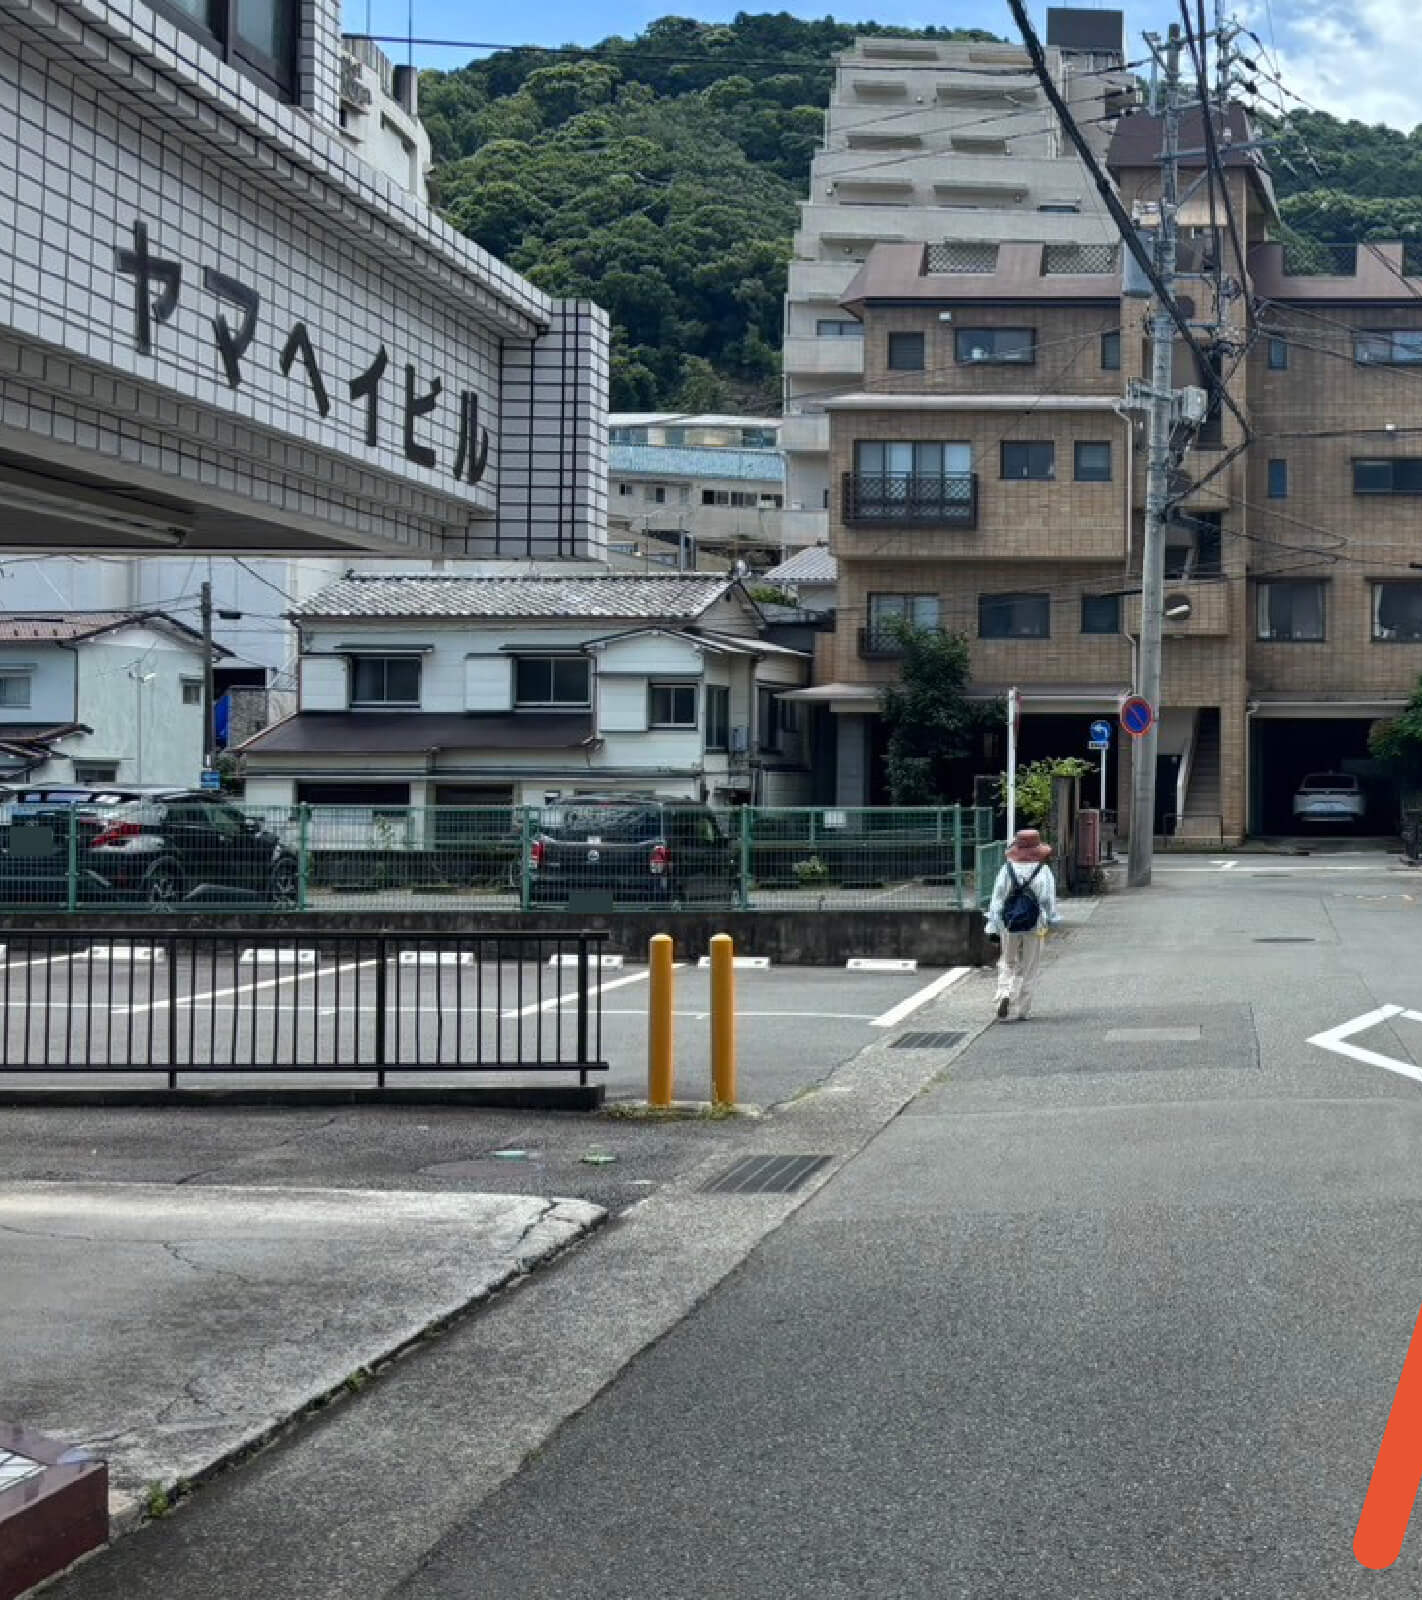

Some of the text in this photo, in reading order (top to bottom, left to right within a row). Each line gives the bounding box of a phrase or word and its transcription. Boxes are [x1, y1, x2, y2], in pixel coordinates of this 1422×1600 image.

[115, 218, 489, 485] ヤマヘイビル
